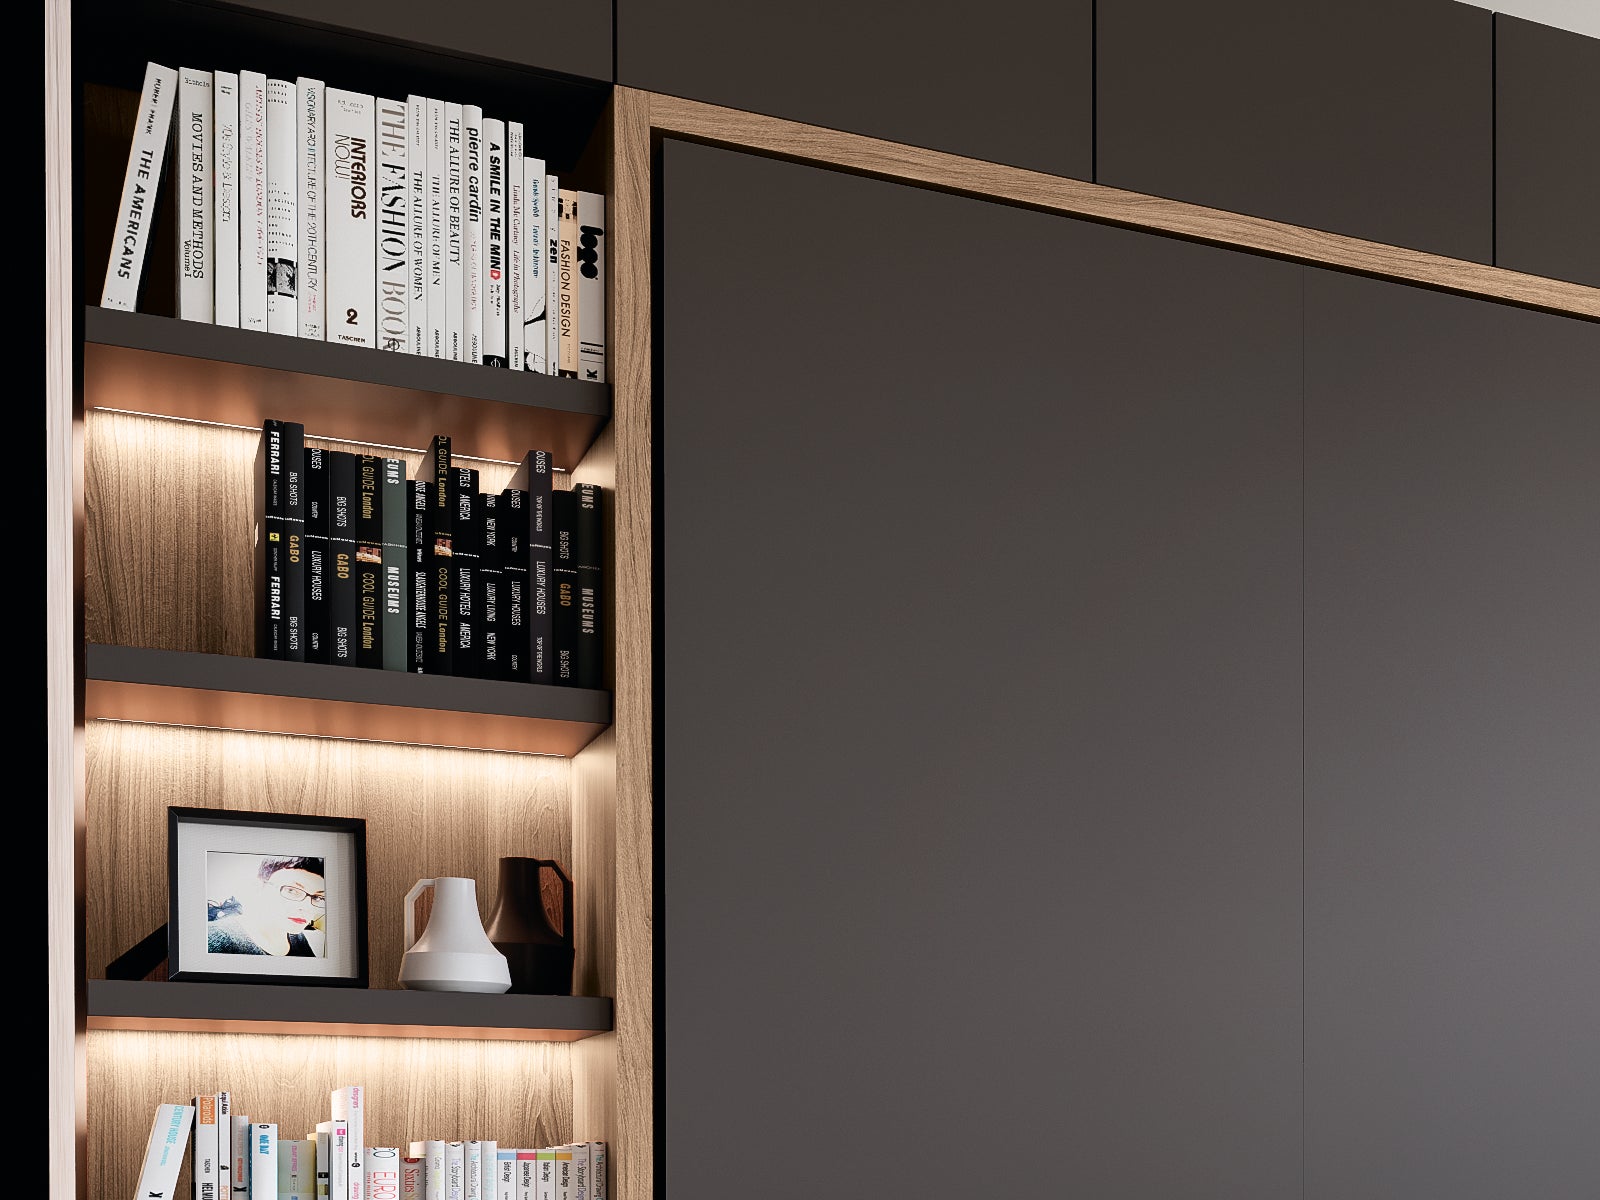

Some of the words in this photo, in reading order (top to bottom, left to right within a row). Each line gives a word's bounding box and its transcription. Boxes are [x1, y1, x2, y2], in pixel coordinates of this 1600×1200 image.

[191, 112, 203, 173] MOVIES
[381, 104, 406, 157] THE
[449, 118, 460, 144] THE
[334, 134, 351, 182] NOW!
[466, 127, 481, 172] pierre
[489, 142, 501, 152] A
[138, 149, 154, 180] THE
[449, 145, 460, 198] ALLURE
[489, 155, 501, 195] SMILE
[350, 137, 366, 220] INTERIORS
[413, 171, 423, 194] THE
[192, 174, 203, 211] AND
[468, 176, 482, 223] cardin
[489, 199, 501, 212] IN
[381, 162, 406, 272] FASHION
[413, 196, 423, 239] ALLURE
[449, 199, 460, 216] OF
[117, 183, 145, 280] AMERICANS
[449, 215, 460, 266] BEAUTY
[489, 216, 501, 241] THE
[184, 240, 192, 271] Volume
[191, 210, 204, 280] METHODS
[413, 240, 423, 257] OF
[549, 238, 559, 265] zen
[489, 243, 501, 281] MIND
[560, 239, 571, 290] FASHION
[413, 258, 423, 302] WOMEN
[346, 308, 359, 326] 2
[560, 293, 571, 338] DESIGN
[337, 335, 367, 345] TASCHEN
[270, 431, 280, 476] FERRARI
[438, 448, 448, 474] GUIDE
[288, 471, 298, 482] BIG
[288, 483, 298, 506] SHOTS
[336, 496, 347, 508] BIG
[438, 478, 448, 507] London
[336, 507, 347, 527] SHOTS
[288, 534, 299, 563] GABO
[311, 550, 322, 575] LUXURY
[336, 552, 349, 579] GABO
[536, 561, 546, 586] LUXURY
[311, 575, 322, 601] HOUSES
[362, 572, 374, 595] COOL
[387, 566, 399, 614] MUSEUMS
[438, 567, 448, 590] COOL
[460, 567, 470, 591] LUXURY
[270, 575, 280, 620] FERRARI
[362, 596, 374, 620] GUIDE
[438, 593, 448, 620] GUIDE
[460, 591, 470, 616] HOTELS
[536, 587, 546, 615] HOUSES
[560, 583, 571, 607] GABO
[288, 616, 298, 628] BIG
[582, 588, 594, 635] MUSEUMS
[288, 628, 298, 650] SHOTS
[362, 621, 374, 649] London
[438, 622, 448, 653] London
[486, 632, 496, 644] NEW
[486, 645, 496, 661] YORK
[202, 1096, 215, 1124] Polaroids
[165, 1127, 178, 1145] HOUSE
